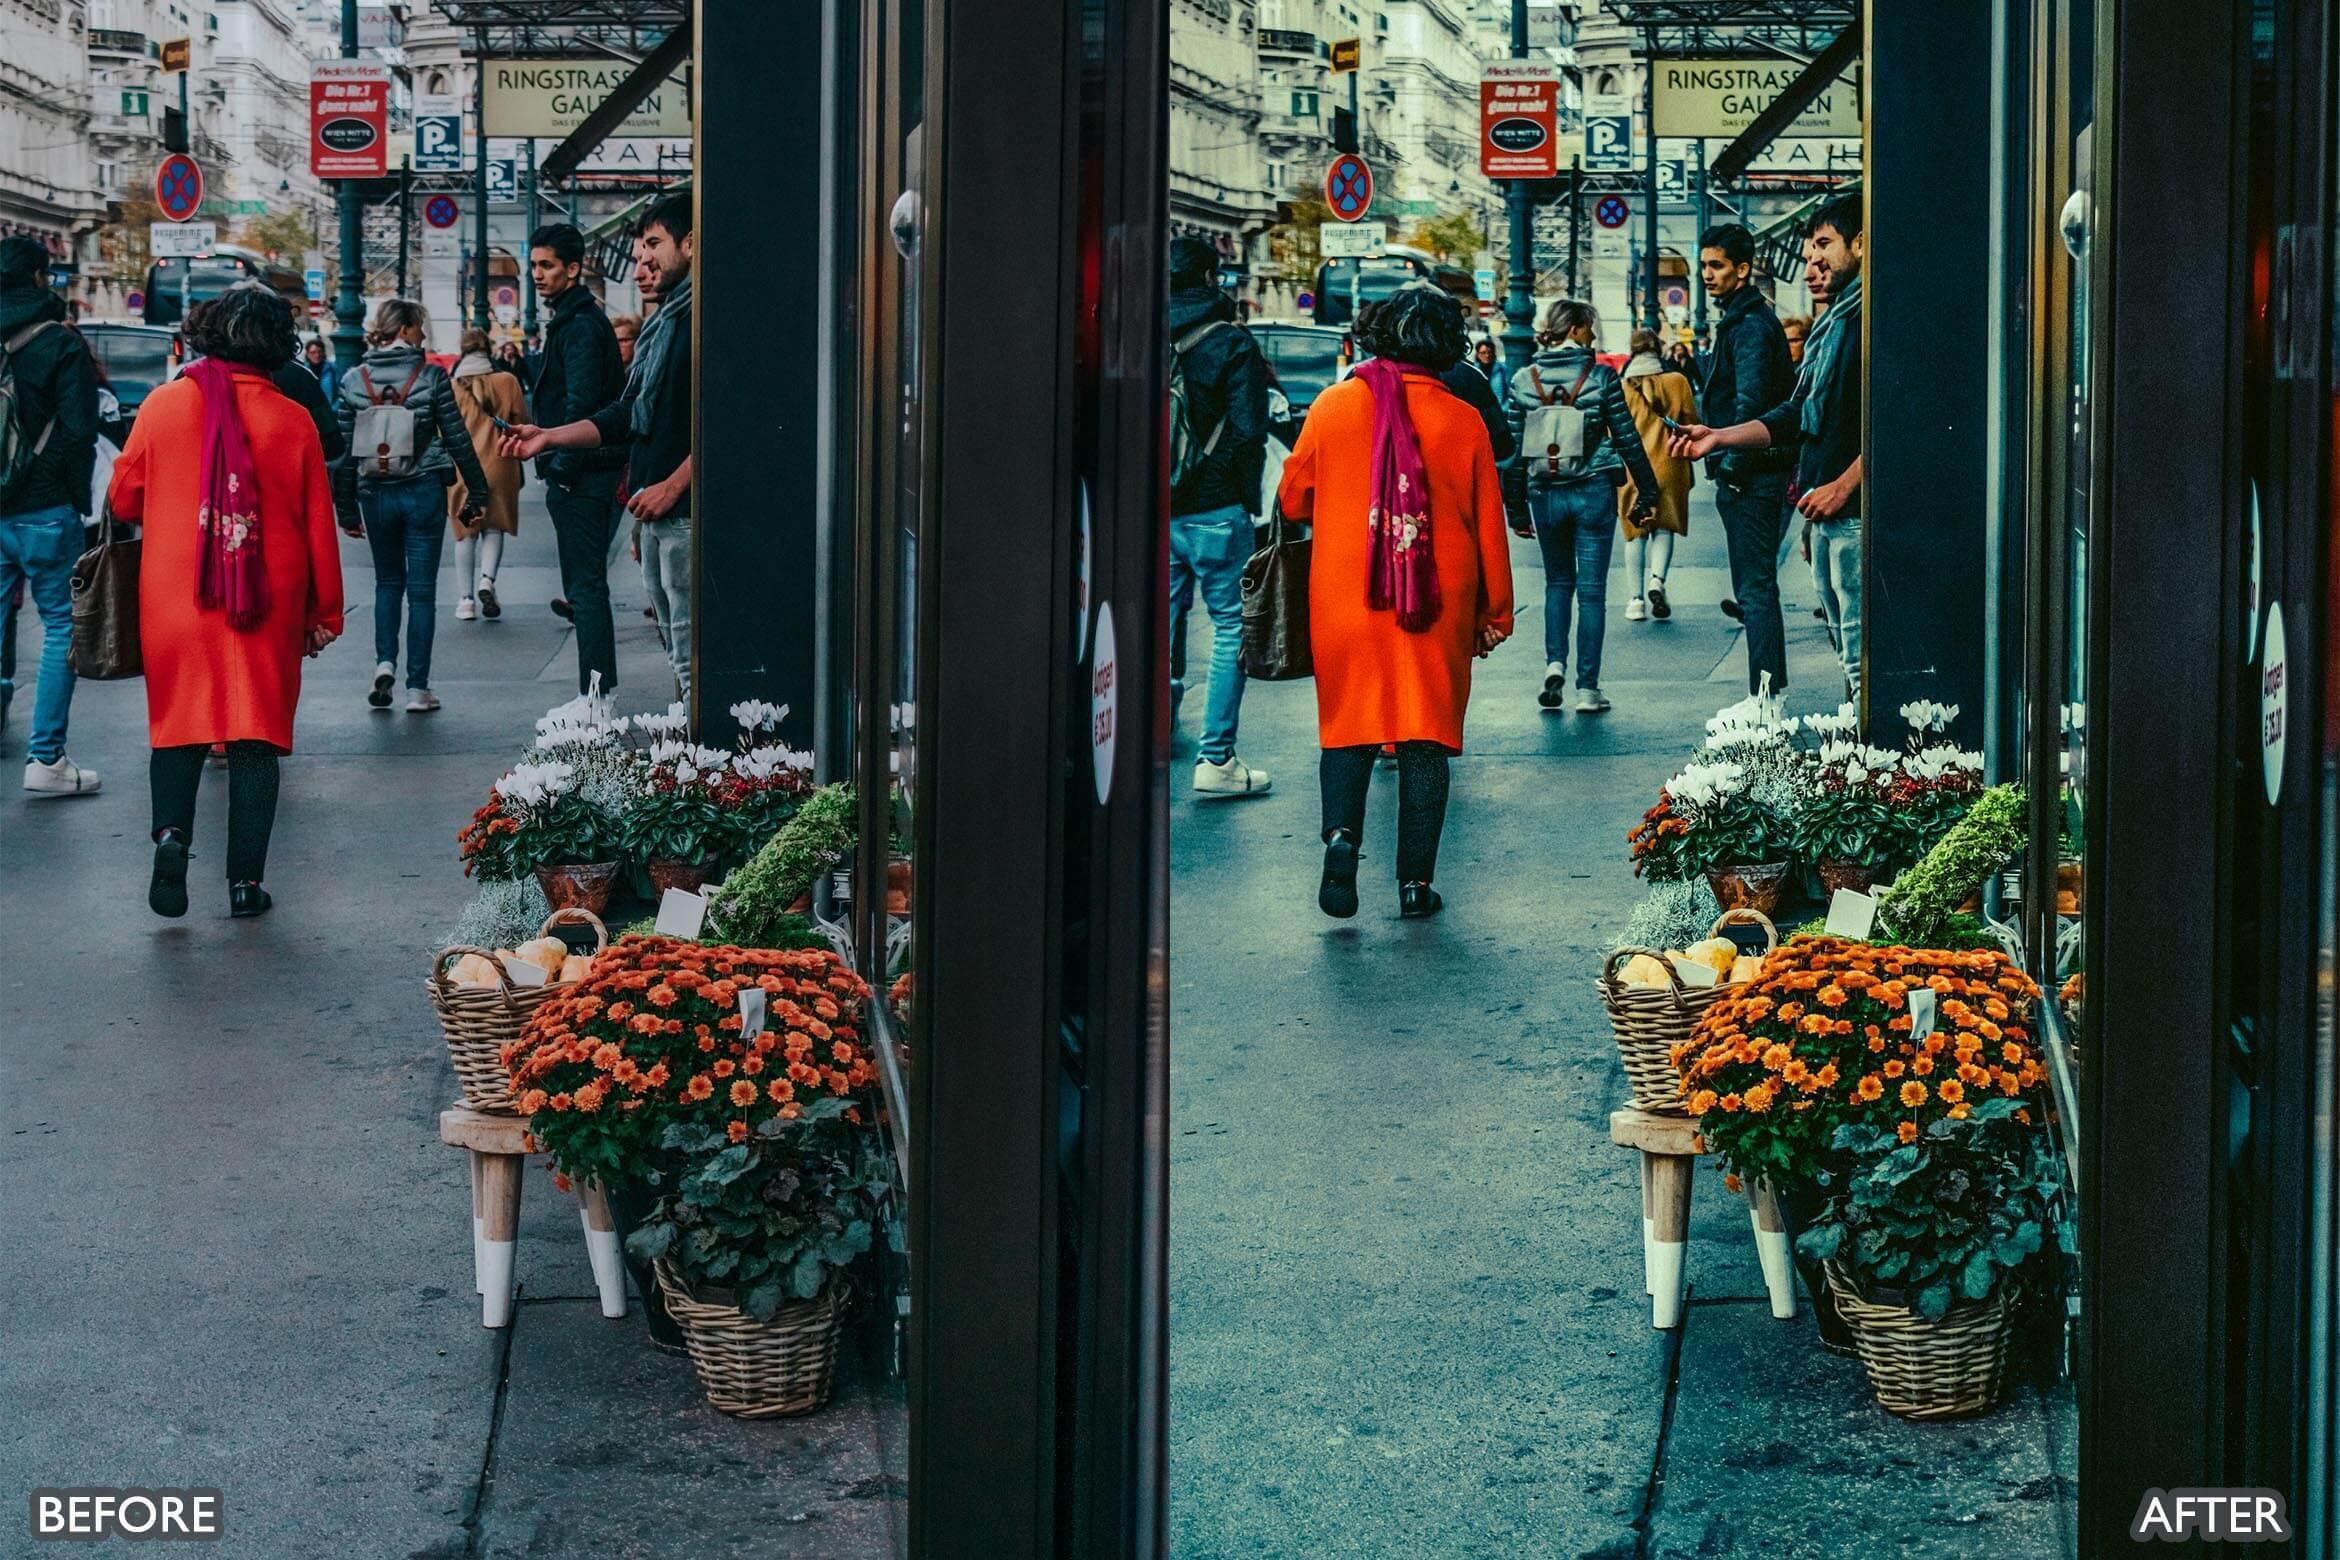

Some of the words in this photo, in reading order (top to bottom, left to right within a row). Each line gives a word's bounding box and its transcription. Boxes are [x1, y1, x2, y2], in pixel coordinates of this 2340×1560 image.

[498, 69, 661, 89] RINGSTRAS
[1668, 69, 1831, 89] RINGSTRAS
[552, 96, 661, 114] GALEN
[1722, 96, 1831, 114] GALEN
[423, 124, 446, 154] P
[1593, 124, 1616, 154] P
